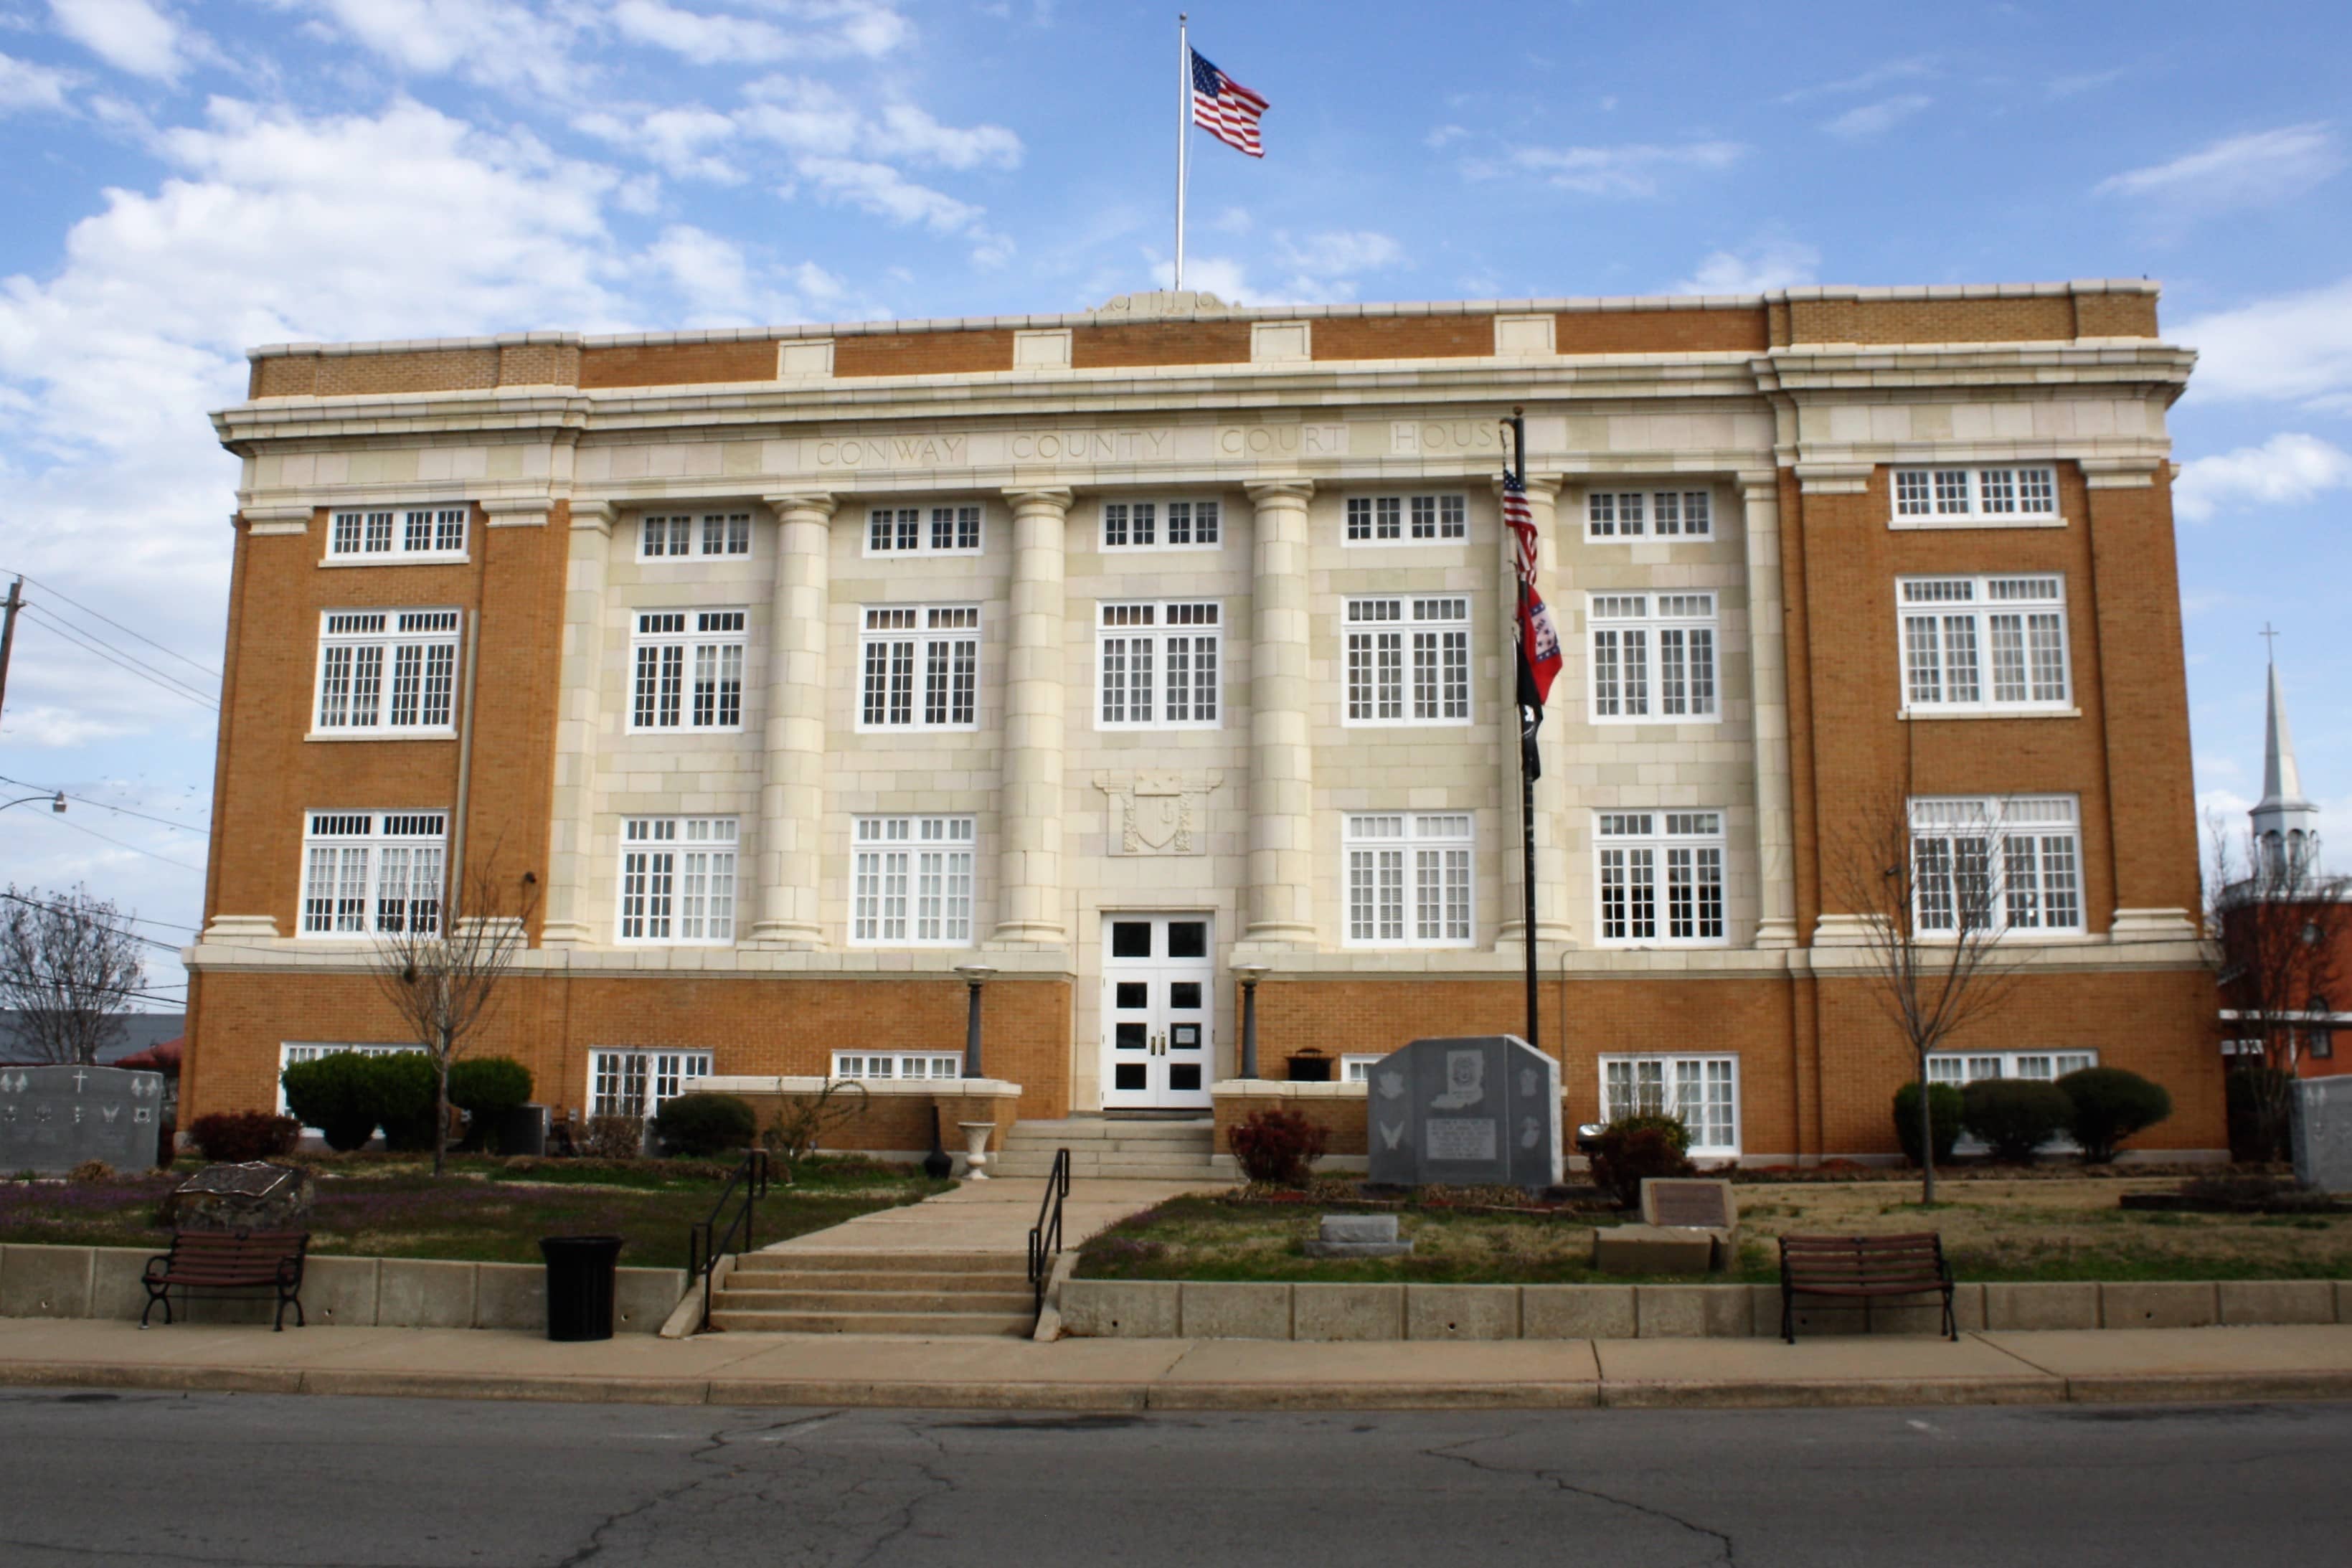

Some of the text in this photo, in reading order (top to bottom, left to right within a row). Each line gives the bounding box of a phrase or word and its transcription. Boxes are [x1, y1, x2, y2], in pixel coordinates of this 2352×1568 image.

[817, 438, 962, 466] CONWAY
[1012, 431, 1168, 459] COUNTY
[1221, 426, 1346, 453] COURT
